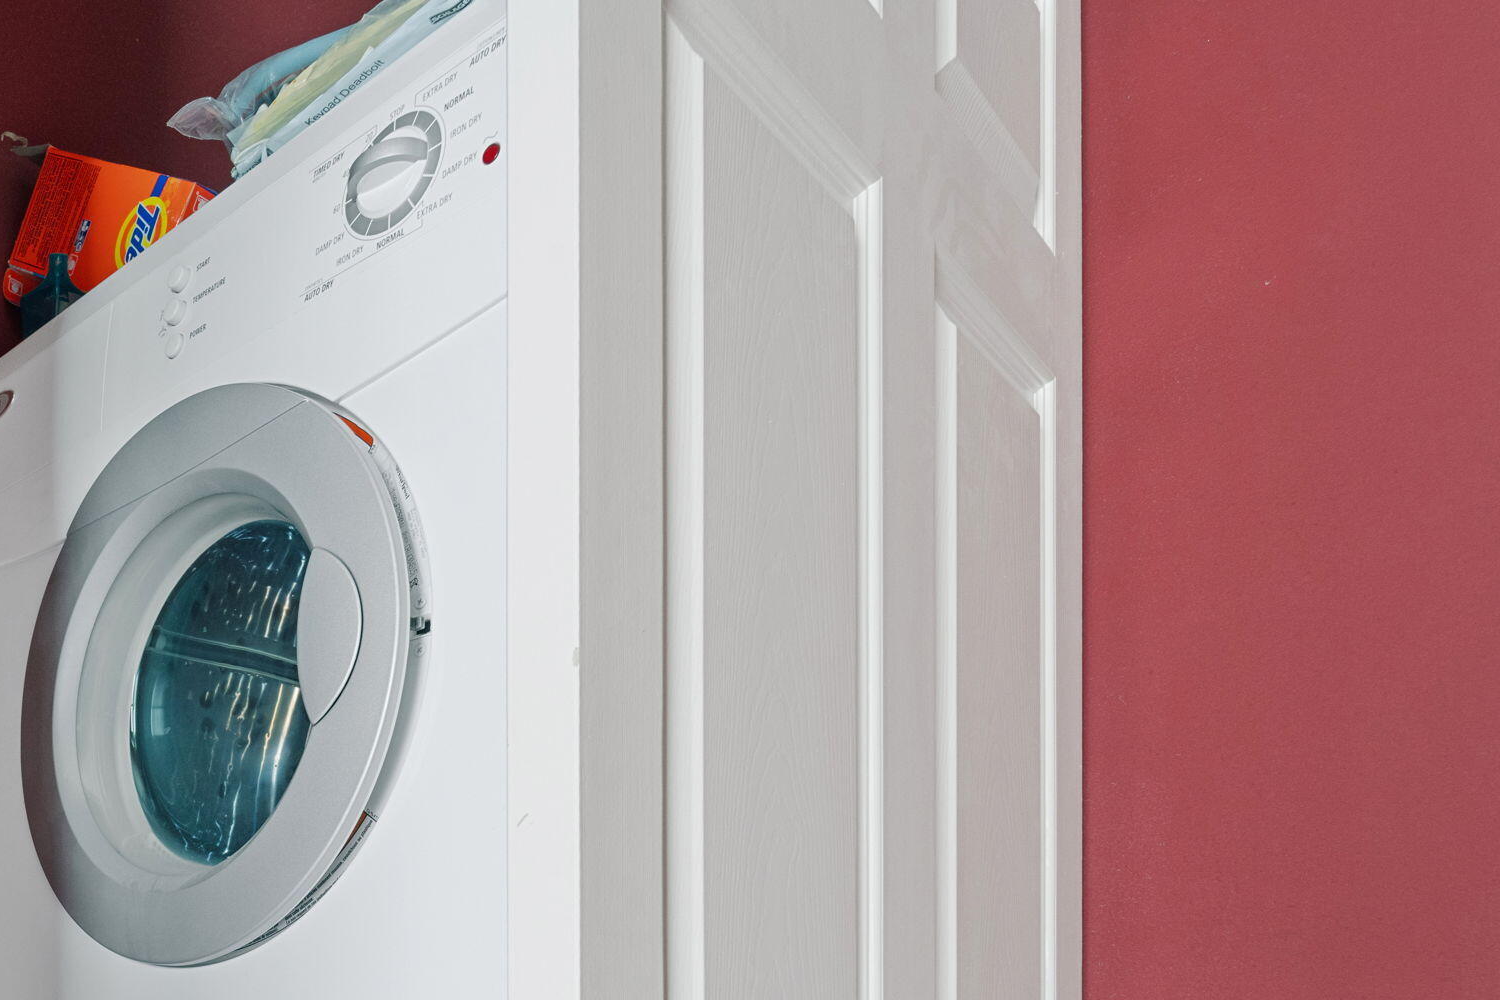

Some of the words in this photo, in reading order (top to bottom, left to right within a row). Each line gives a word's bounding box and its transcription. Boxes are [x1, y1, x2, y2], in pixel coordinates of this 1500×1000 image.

[469, 47, 489, 68] AUTO
[491, 33, 506, 52] DRY
[304, 96, 342, 126] Keypad
[339, 59, 384, 98] Deadbolt
[422, 81, 442, 102] EXTRA
[444, 71, 458, 88] DRY
[443, 86, 475, 112] NORMAL
[450, 122, 467, 138] IRON
[468, 112, 482, 129] DRY
[332, 151, 344, 166] DRY
[442, 161, 461, 179] DAMP
[463, 151, 478, 166] DRY
[416, 201, 437, 220] EXTRA
[439, 193, 453, 208] DRY
[125, 201, 161, 263] Tide
[315, 240, 332, 256] DAMP
[333, 232, 345, 245] DRY
[376, 229, 404, 250] NORMAL
[196, 256, 210, 272] START
[352, 245, 364, 259] DRY
[192, 276, 226, 304] TEMPERATURE
[304, 286, 320, 302] AUTO
[322, 279, 334, 292] DRY
[189, 323, 207, 339] POWER
